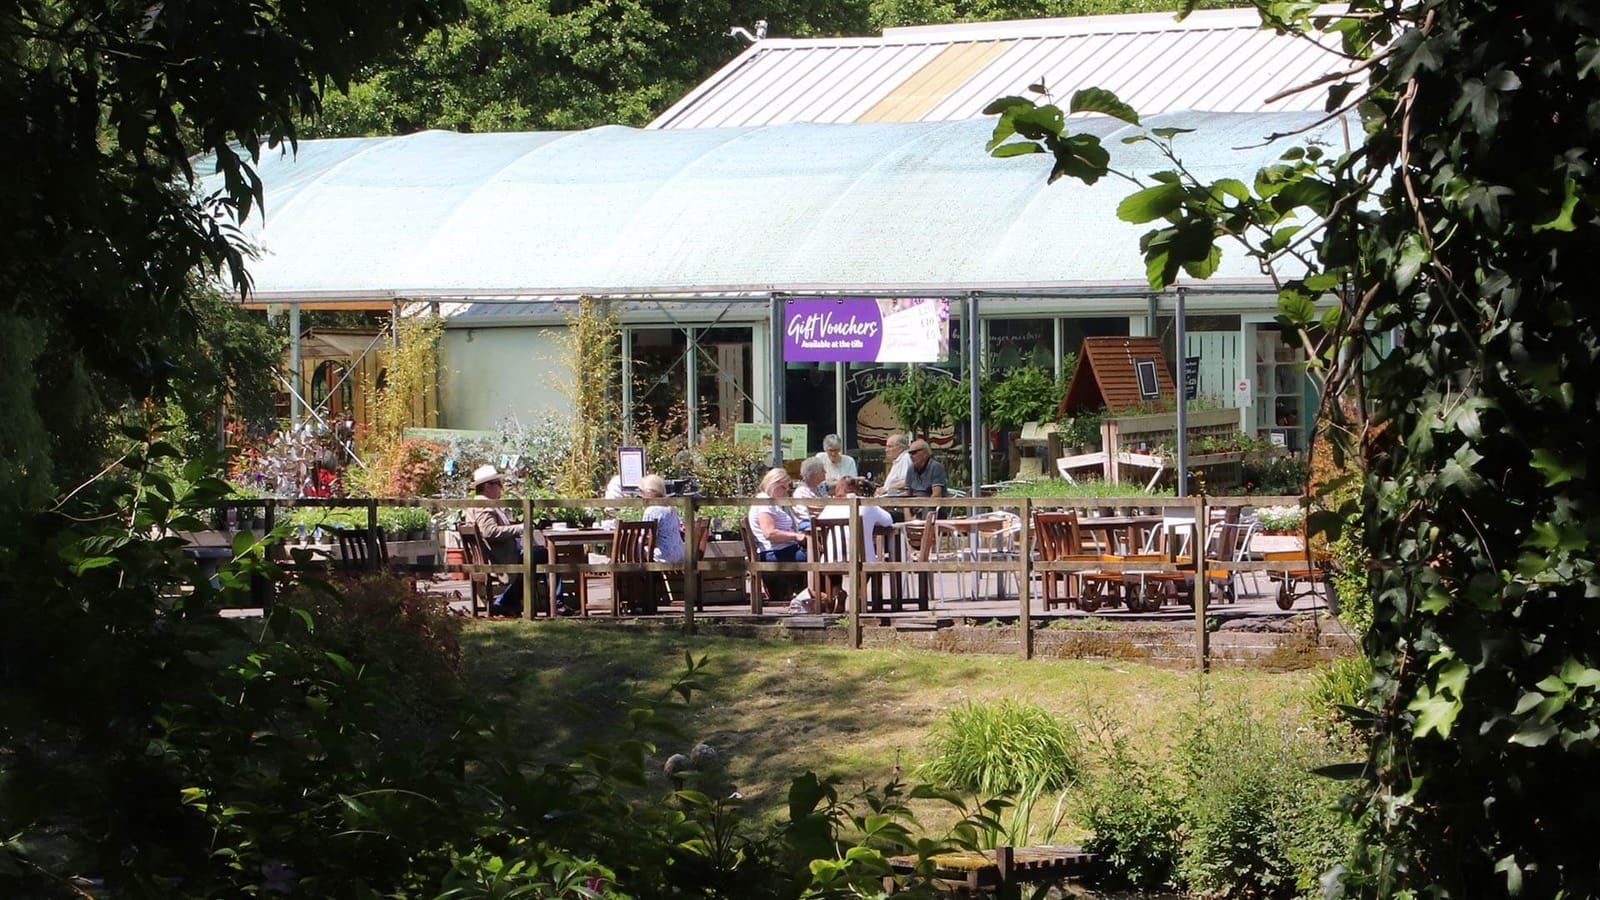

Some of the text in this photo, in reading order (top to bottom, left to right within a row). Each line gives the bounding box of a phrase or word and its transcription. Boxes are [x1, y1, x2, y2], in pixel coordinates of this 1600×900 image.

[787, 311, 878, 344] Gift Vouchers
[801, 340, 831, 348] Available
[839, 340, 850, 348] the
[851, 340, 864, 348] tills
